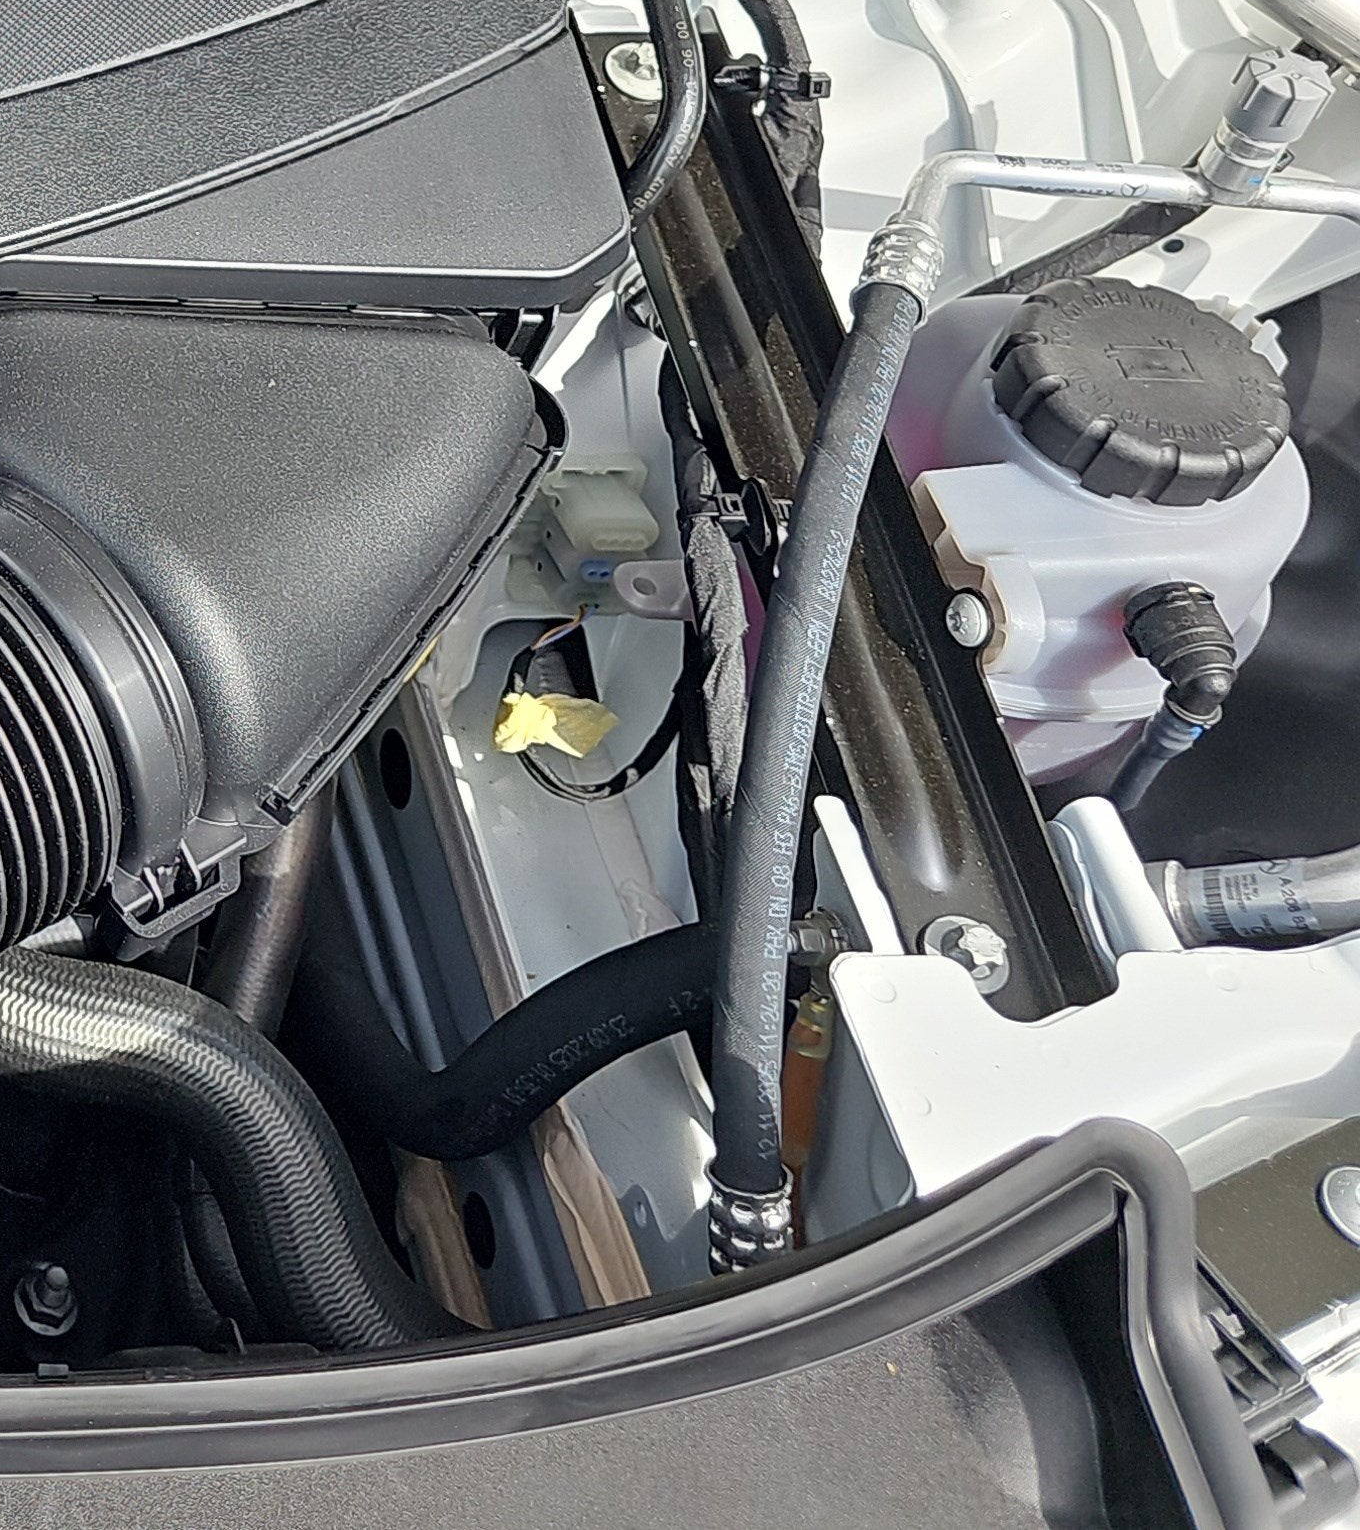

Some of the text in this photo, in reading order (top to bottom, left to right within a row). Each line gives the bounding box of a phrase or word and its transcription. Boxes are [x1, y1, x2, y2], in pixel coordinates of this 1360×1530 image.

[676, 21, 689, 39] 00
[683, 48, 694, 68] 06
[664, 118, 692, 167] A206
[1083, 291, 1132, 309] OPEN
[1278, 876, 1293, 887] A
